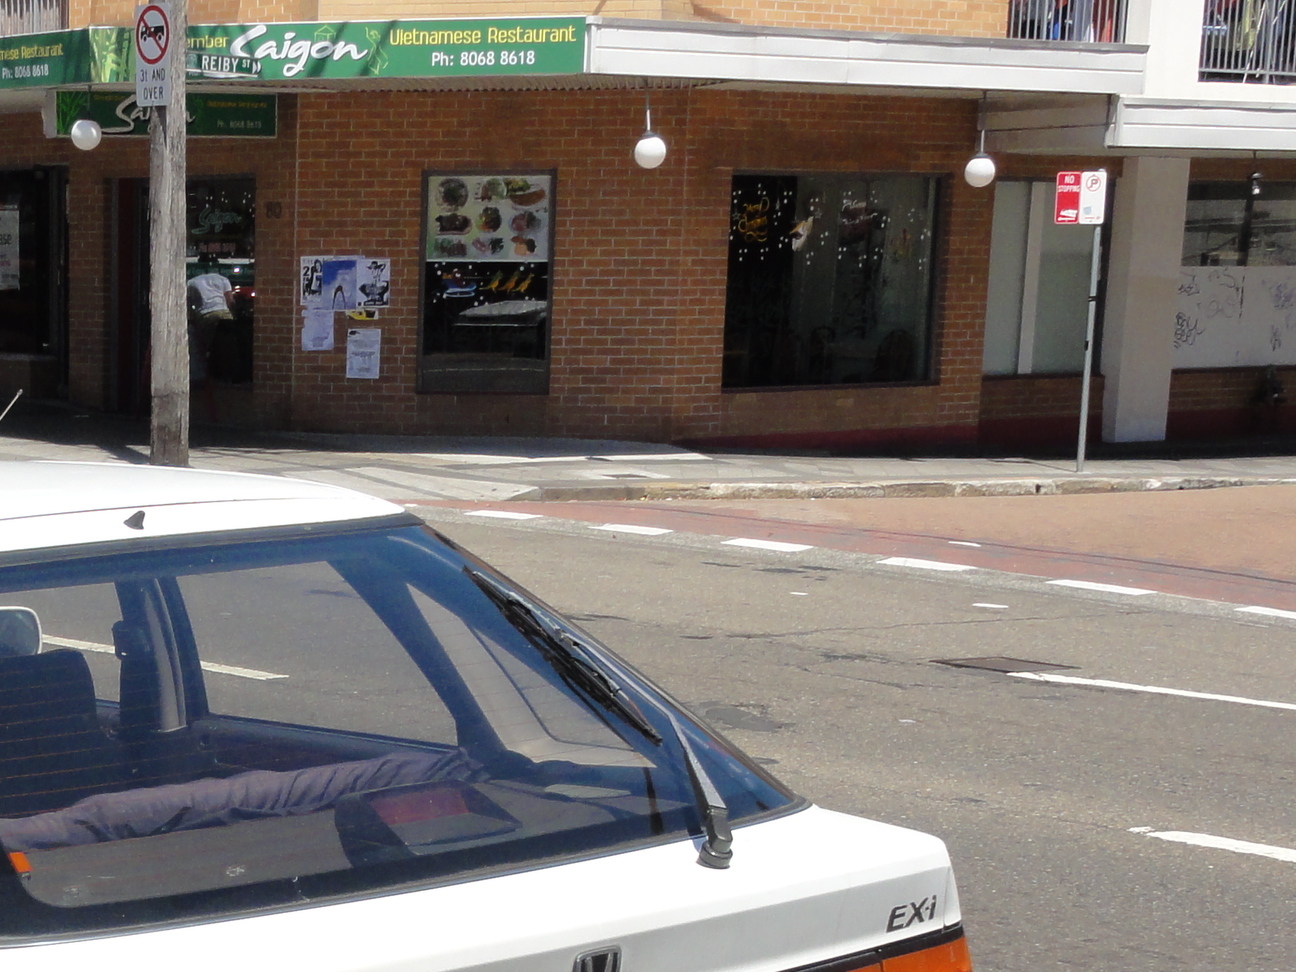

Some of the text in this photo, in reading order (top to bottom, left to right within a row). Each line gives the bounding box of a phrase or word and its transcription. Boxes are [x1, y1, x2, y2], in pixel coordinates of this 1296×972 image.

[185, 35, 229, 49] ember
[488, 25, 577, 44] Restaurant
[21, 43, 64, 60] Restaurant
[432, 50, 535, 67] Ph: 8068 8618
[1, 64, 49, 79] Ph: 8068 8618
[201, 55, 251, 73] REIBY ST
[151, 68, 166, 81] AND
[143, 88, 164, 101] OVER
[1064, 175, 1075, 184] NO
